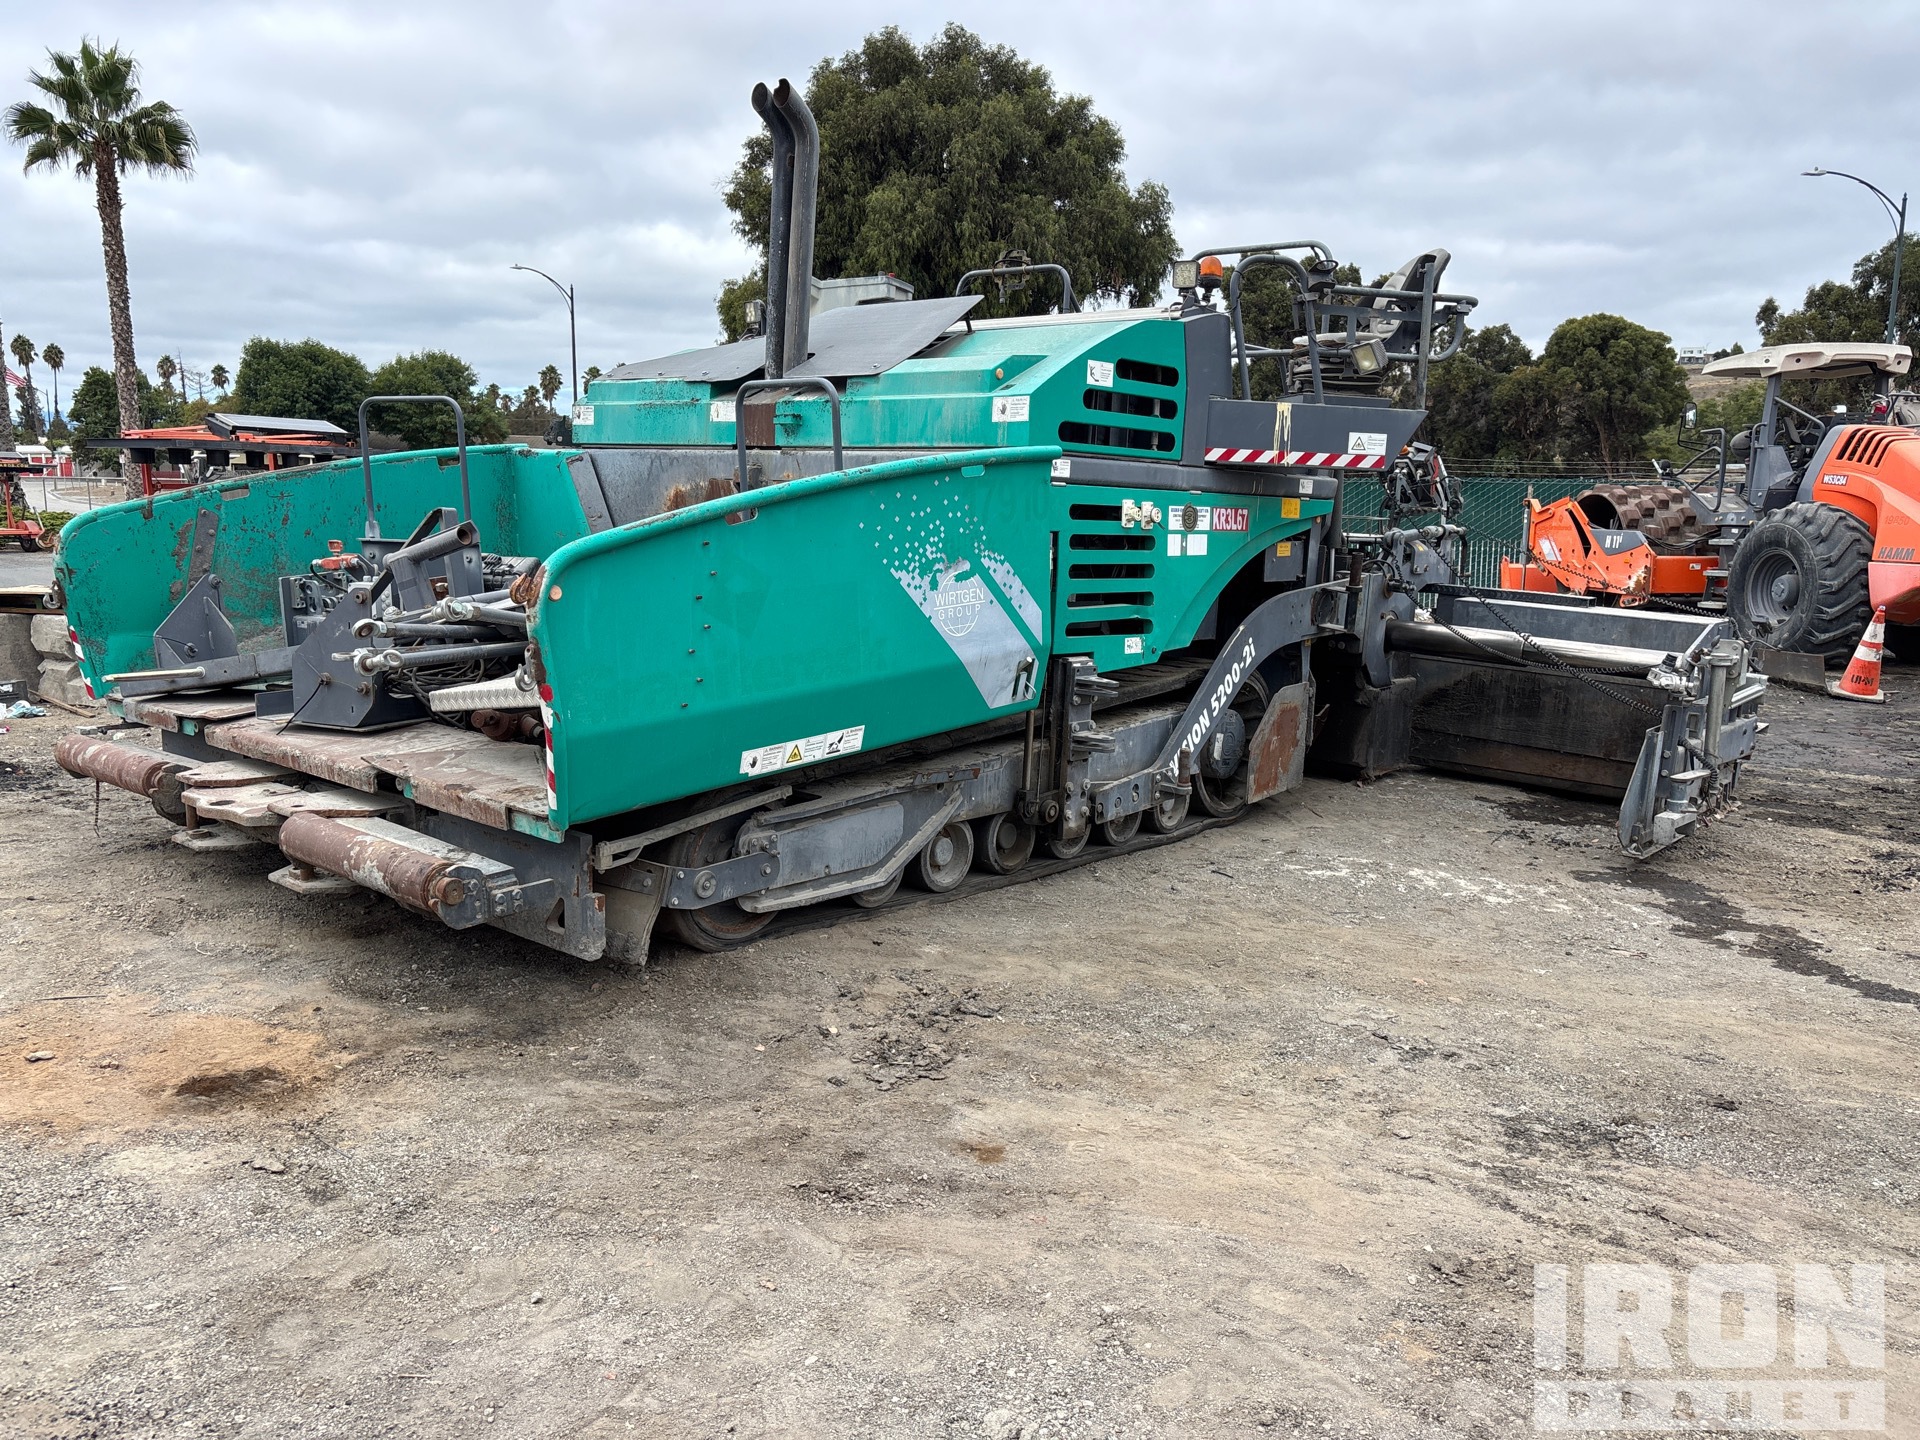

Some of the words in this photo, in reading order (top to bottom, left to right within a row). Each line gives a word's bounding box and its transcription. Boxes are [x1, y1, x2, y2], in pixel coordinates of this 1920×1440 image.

[1212, 508, 1249, 531] KR3L67
[1605, 535, 1612, 548] H
[1878, 546, 1916, 561] HAMM
[934, 587, 984, 607] WIRTGEN
[938, 604, 981, 620] GROUP
[1168, 708, 1211, 777] VION
[1210, 637, 1256, 717] 5200-2i
